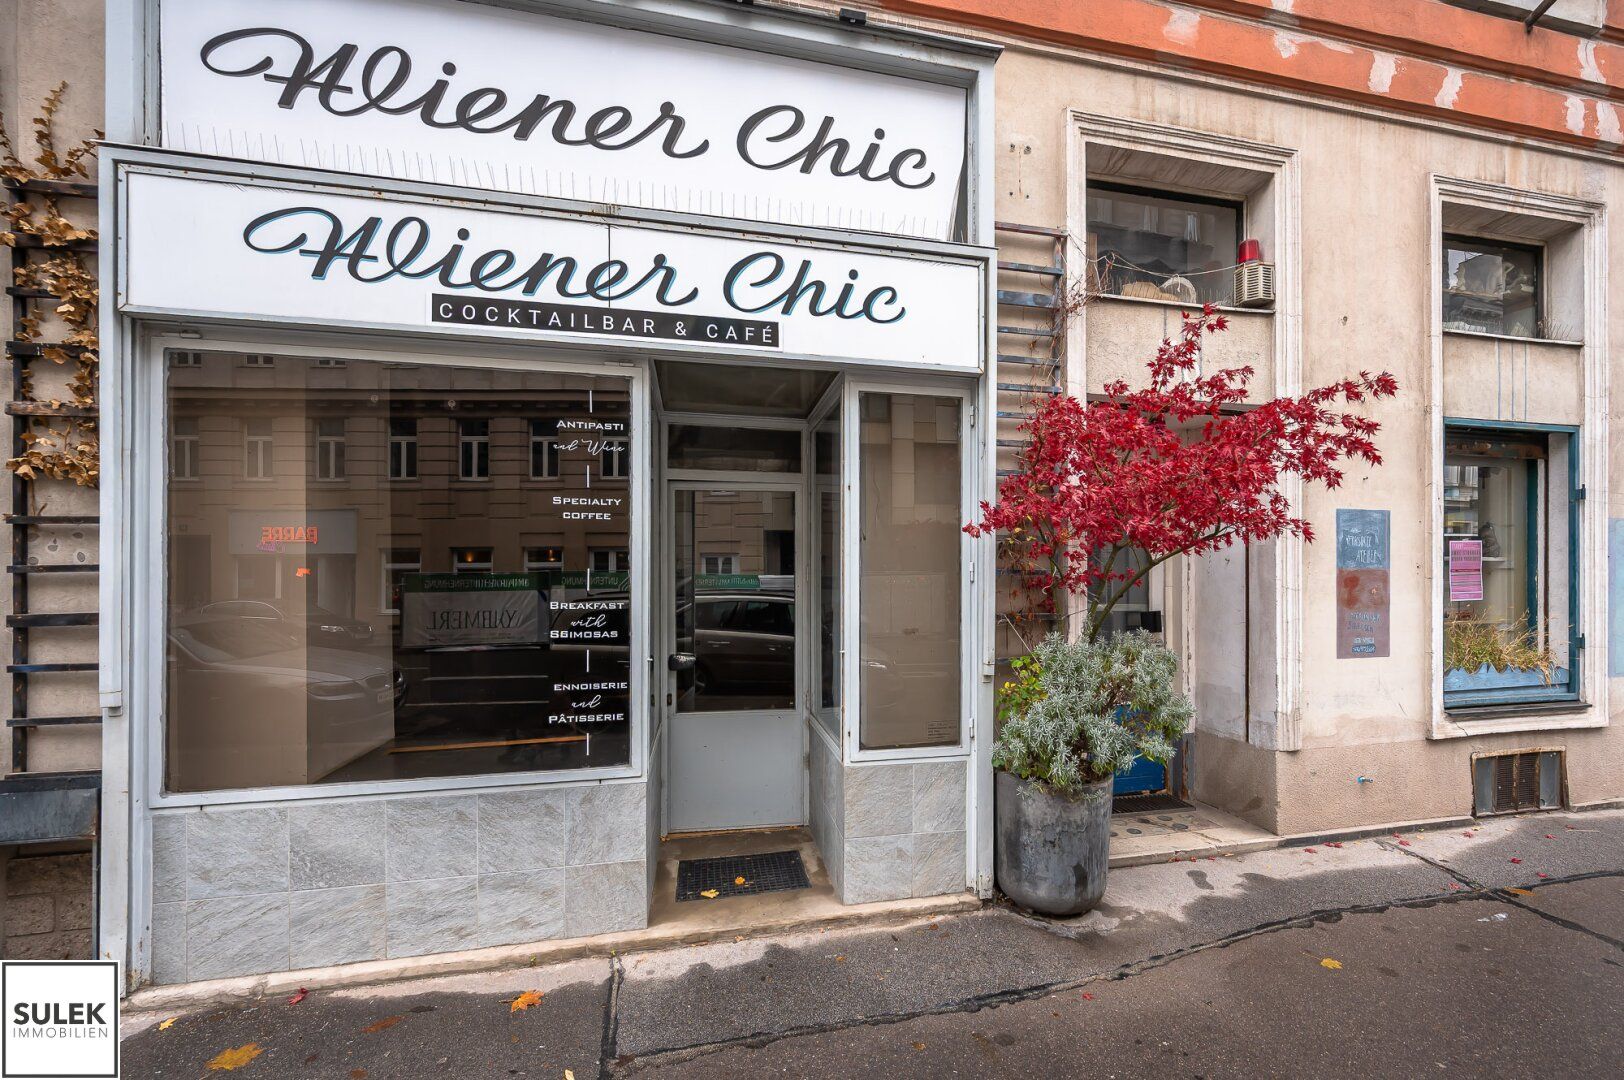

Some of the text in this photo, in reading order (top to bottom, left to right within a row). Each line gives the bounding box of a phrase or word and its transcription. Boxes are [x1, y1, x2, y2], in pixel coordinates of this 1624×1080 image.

[200, 28, 936, 190] Wiener Chic
[243, 206, 906, 325] Wiener Chic
[439, 302, 773, 343] COCKTAILBAR & CAFÉ
[556, 420, 624, 431] ANTIPASTI
[581, 438, 625, 456] Wine
[552, 496, 622, 506] SPECIALTY
[562, 511, 612, 520] COFFEE
[550, 601, 625, 610] BREAKFAST
[570, 614, 607, 628] with
[553, 682, 629, 691] ENNOISERIE
[571, 694, 602, 708] and
[548, 712, 625, 724] PÂTISSERIE
